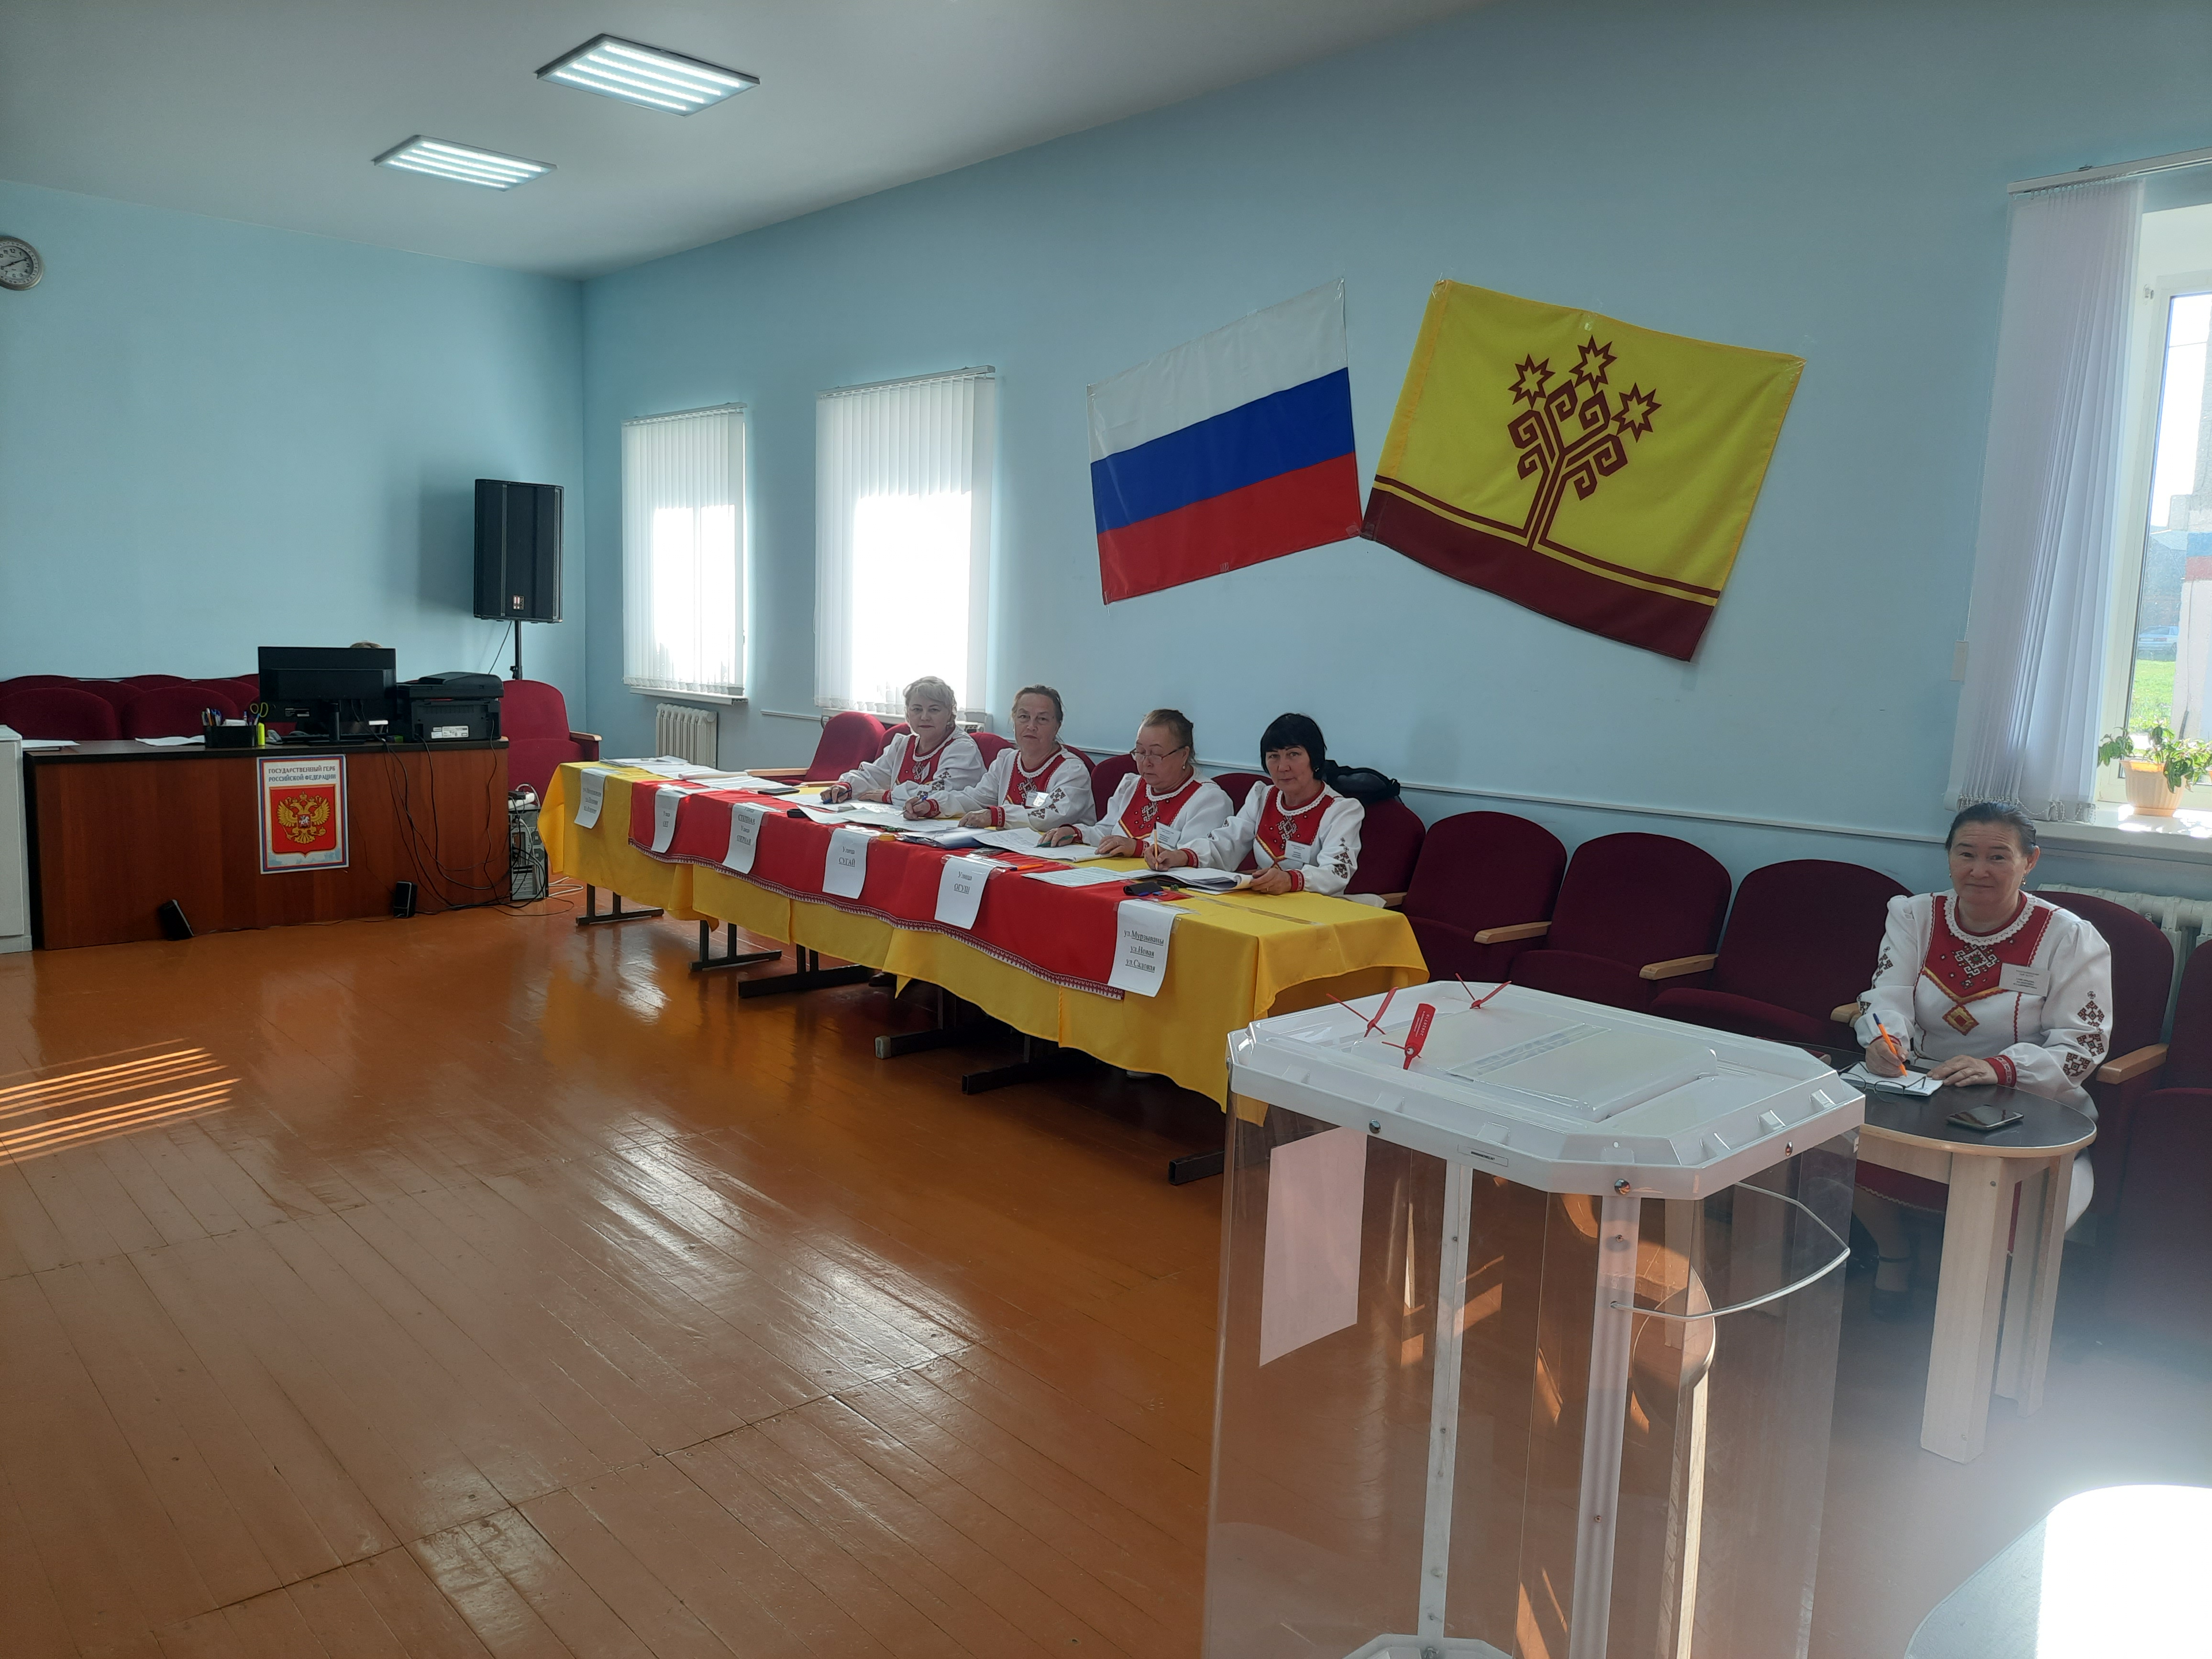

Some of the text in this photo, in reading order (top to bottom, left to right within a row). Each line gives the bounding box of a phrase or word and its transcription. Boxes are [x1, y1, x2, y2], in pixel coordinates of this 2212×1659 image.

[268, 765, 321, 774] ГОСУДАРСТВЕННЫЙ
[268, 774, 304, 782] РОССИЙСКОЙ
[839, 857, 855, 866] СУГАЙ
[958, 871, 972, 881] Улица
[1124, 930, 1164, 945] ул.Мурзываны
[1130, 946, 1154, 957] ул.Новая
[1126, 959, 1155, 972] ул.Садовая
